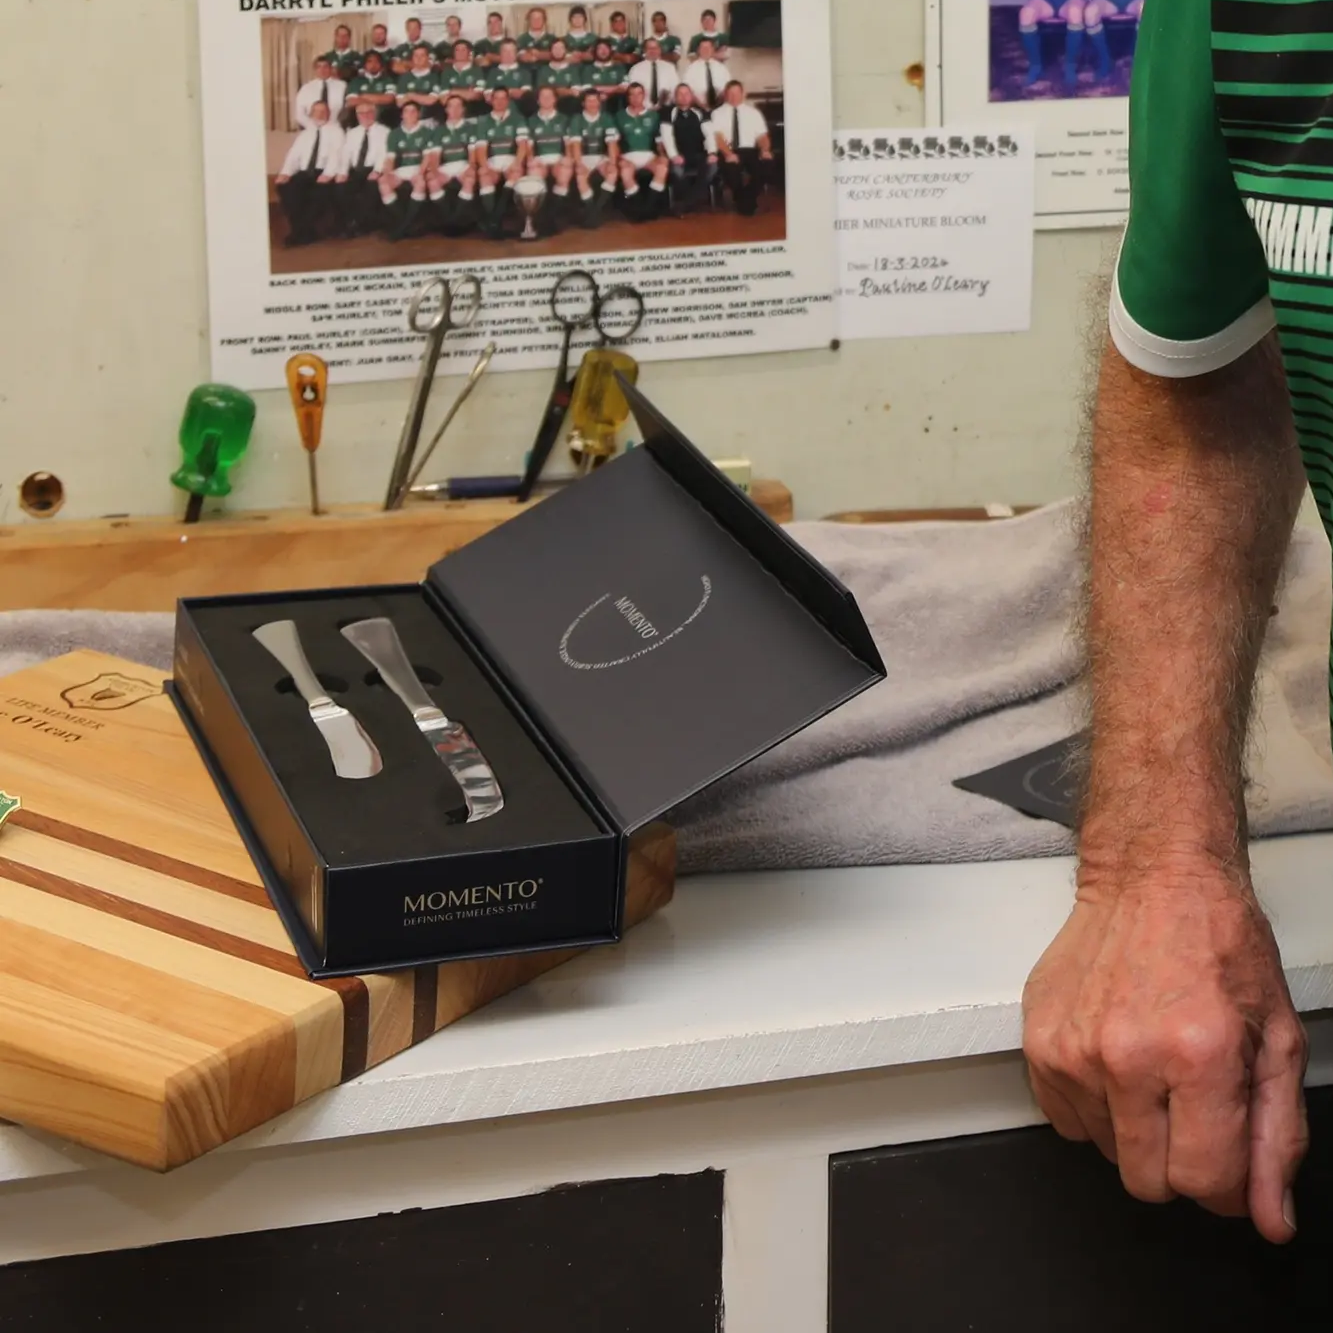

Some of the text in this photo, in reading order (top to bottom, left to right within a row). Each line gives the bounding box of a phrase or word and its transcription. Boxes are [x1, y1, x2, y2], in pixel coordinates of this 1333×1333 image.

[872, 172, 975, 186] CANTERBURY
[846, 187, 949, 201] ROSE SOCIETY
[862, 218, 938, 230] MINIATURE
[940, 215, 988, 227] BLOOM
[700, 248, 748, 258] MATTHEW
[858, 276, 929, 298] Pauline
[931, 274, 992, 298] O'Leary
[38, 706, 105, 731] MEMBER
[403, 900, 538, 927] DEFINING TIMELESS STYLE
